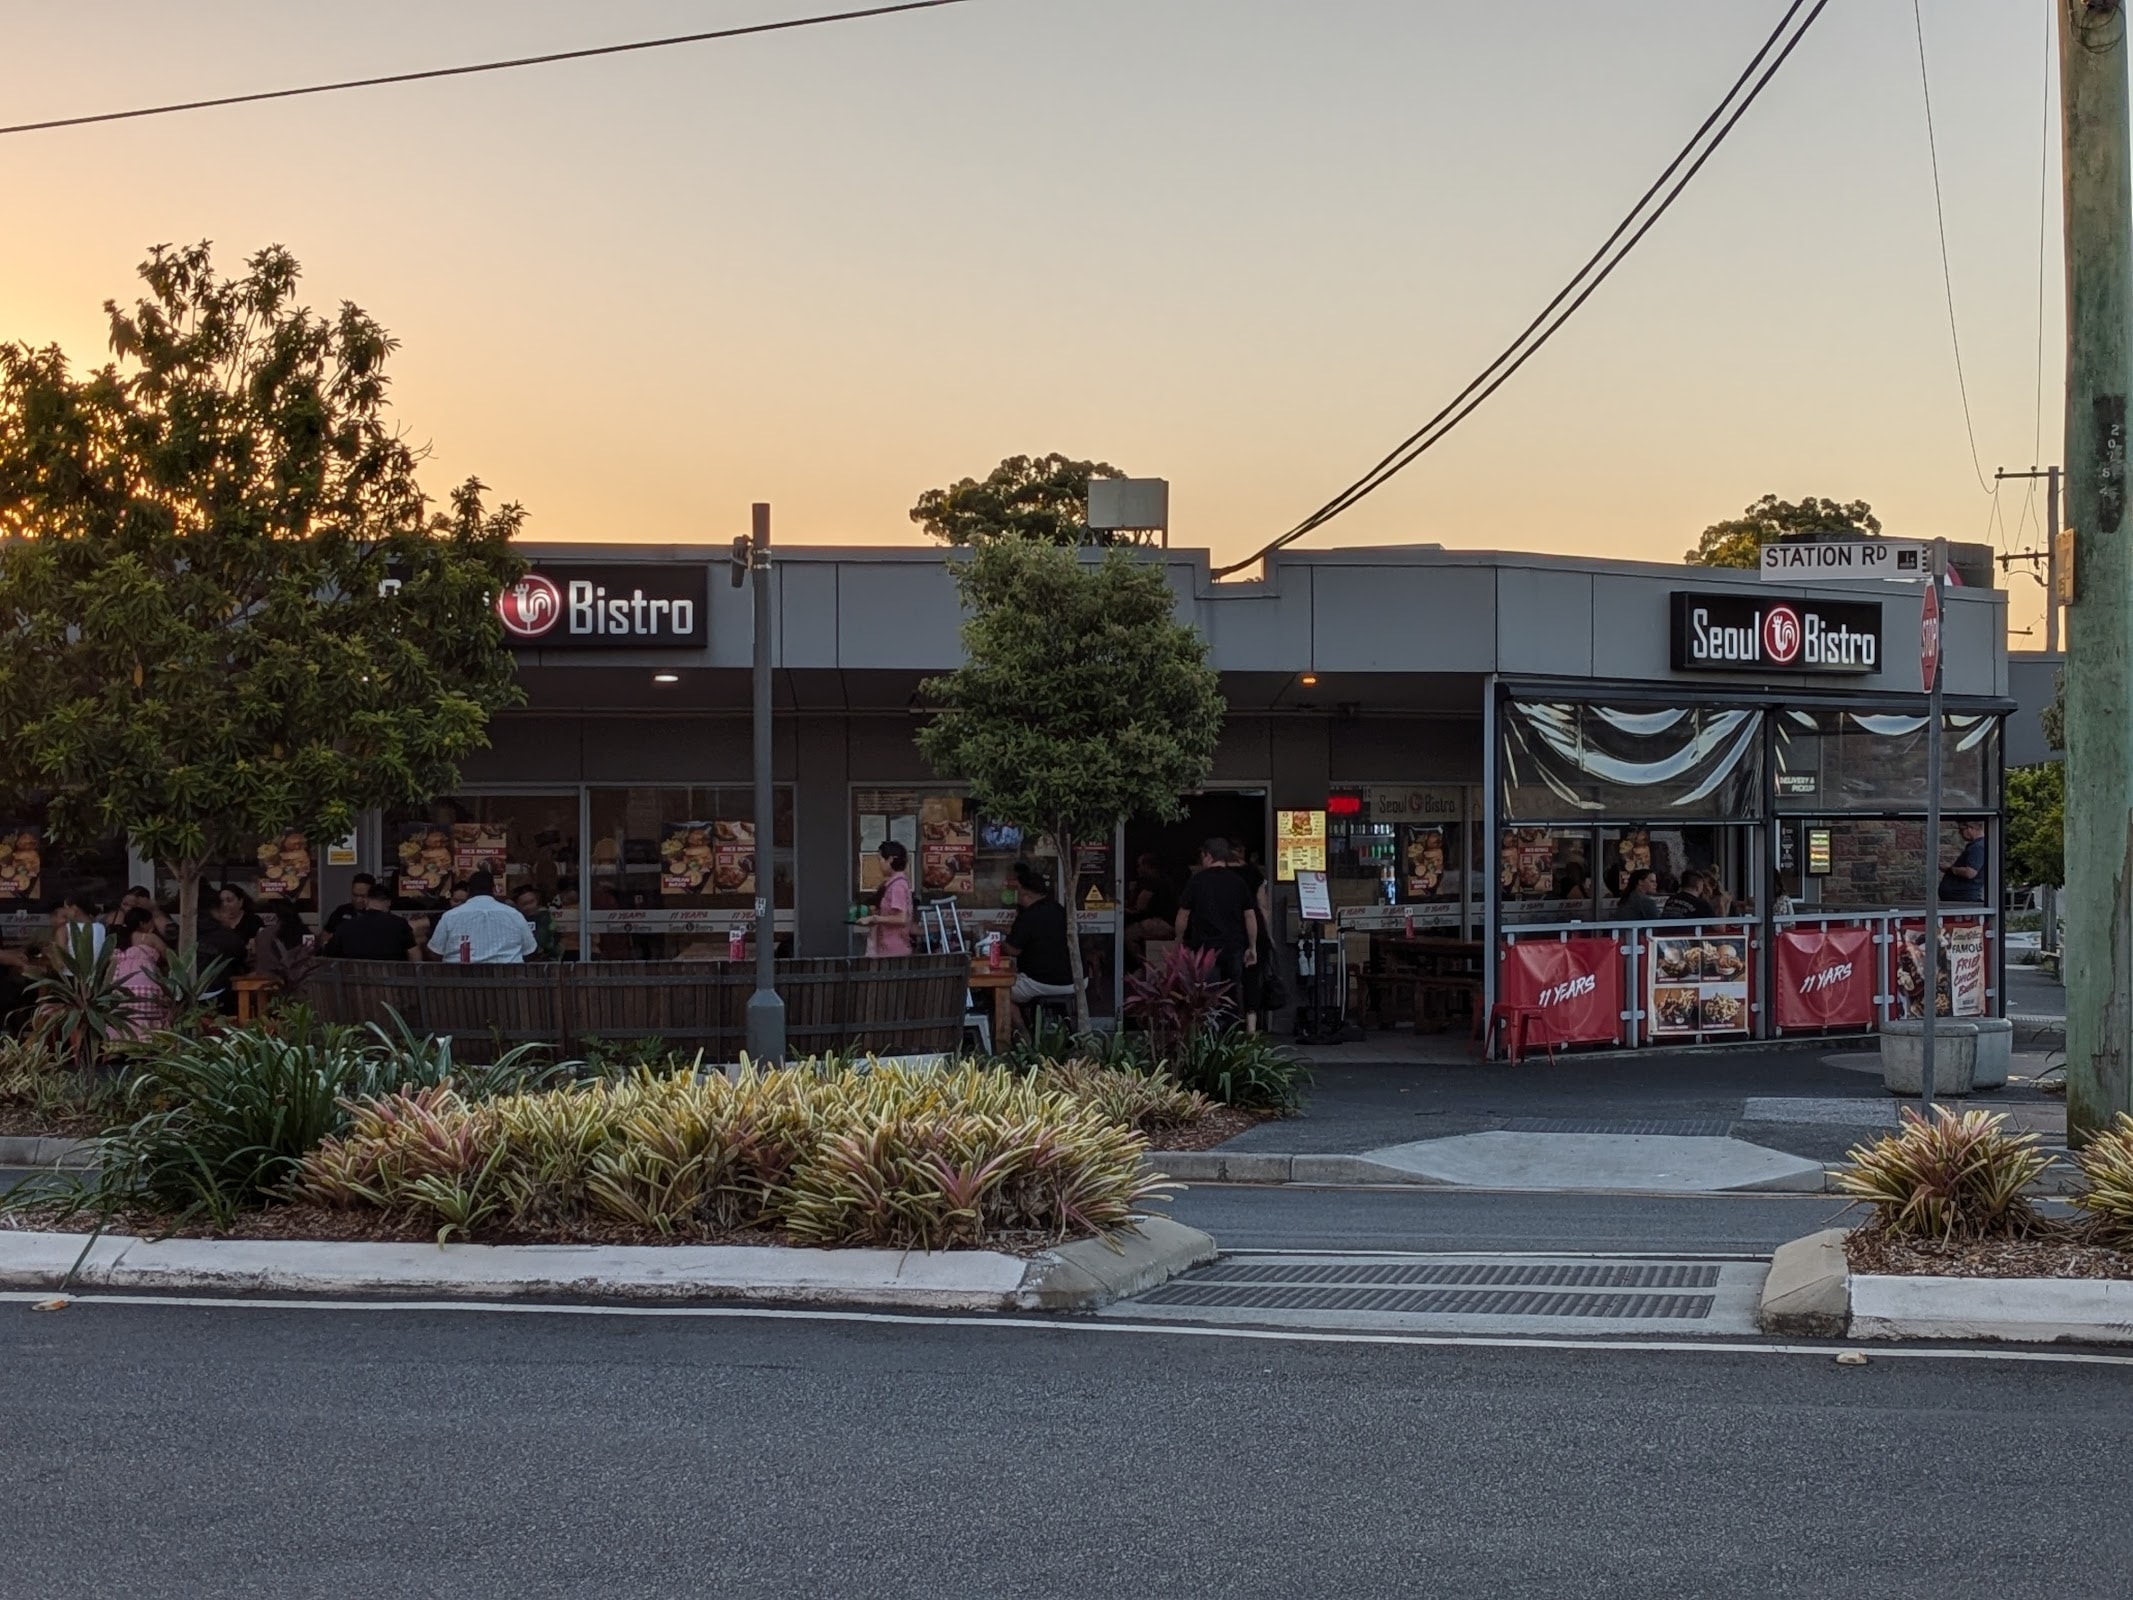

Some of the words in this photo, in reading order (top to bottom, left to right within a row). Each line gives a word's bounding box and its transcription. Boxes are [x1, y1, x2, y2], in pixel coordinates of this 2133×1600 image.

[1766, 547, 1852, 567] STATION
[1862, 546, 1887, 565] RD
[568, 580, 694, 635] Bistro
[1693, 608, 1760, 661] Seoul
[1804, 613, 1876, 665] Bistro
[1921, 617, 1937, 658] STOP
[1379, 794, 1407, 813] Seoul
[1424, 794, 1455, 813] Bistro
[1538, 989, 1552, 1008] 11
[1552, 974, 1596, 1006] YEARS
[1800, 974, 1816, 994] 11
